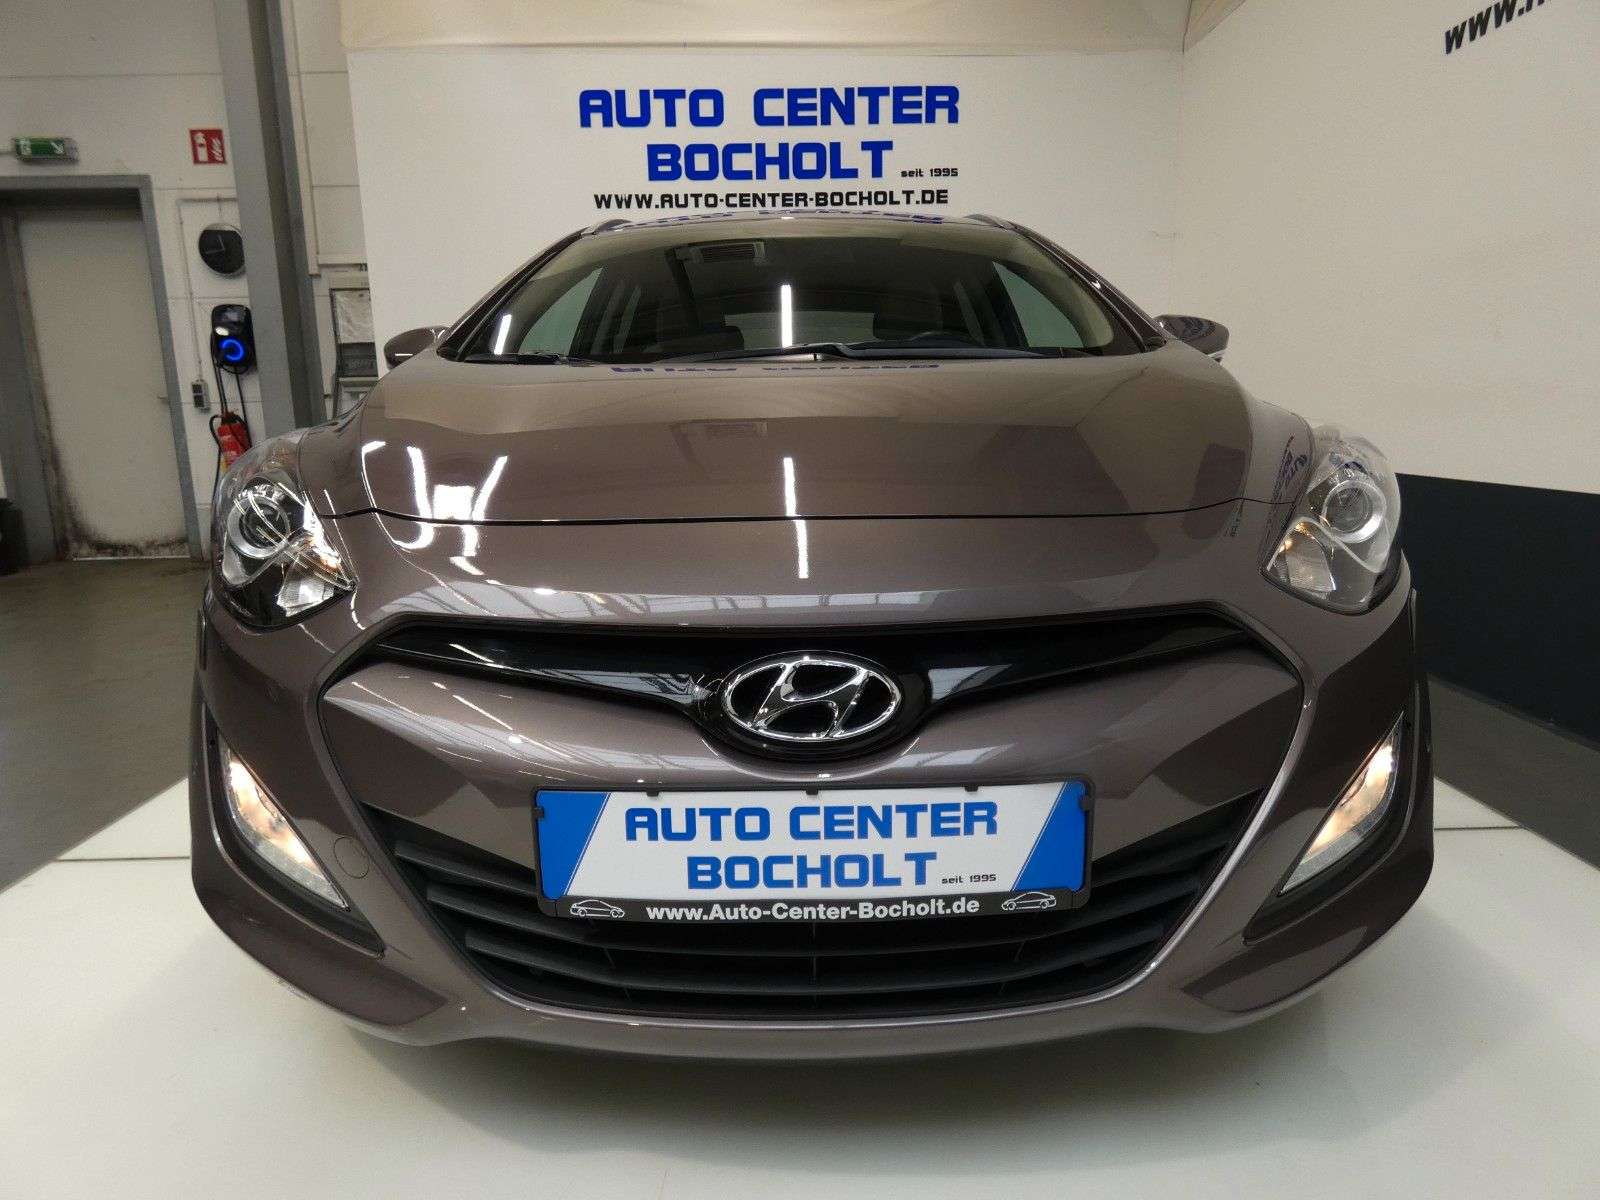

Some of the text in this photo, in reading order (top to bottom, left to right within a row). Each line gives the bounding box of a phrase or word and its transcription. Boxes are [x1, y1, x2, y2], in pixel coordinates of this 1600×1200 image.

[579, 85, 960, 128] AUTO CENTER
[646, 140, 959, 182] BOCHOLT seit 1995
[624, 800, 998, 842] AUTO CENTER
[687, 851, 997, 891] BOCHOLT seit 1995
[645, 896, 980, 922] www.Auto-Center-Bocholt.de
